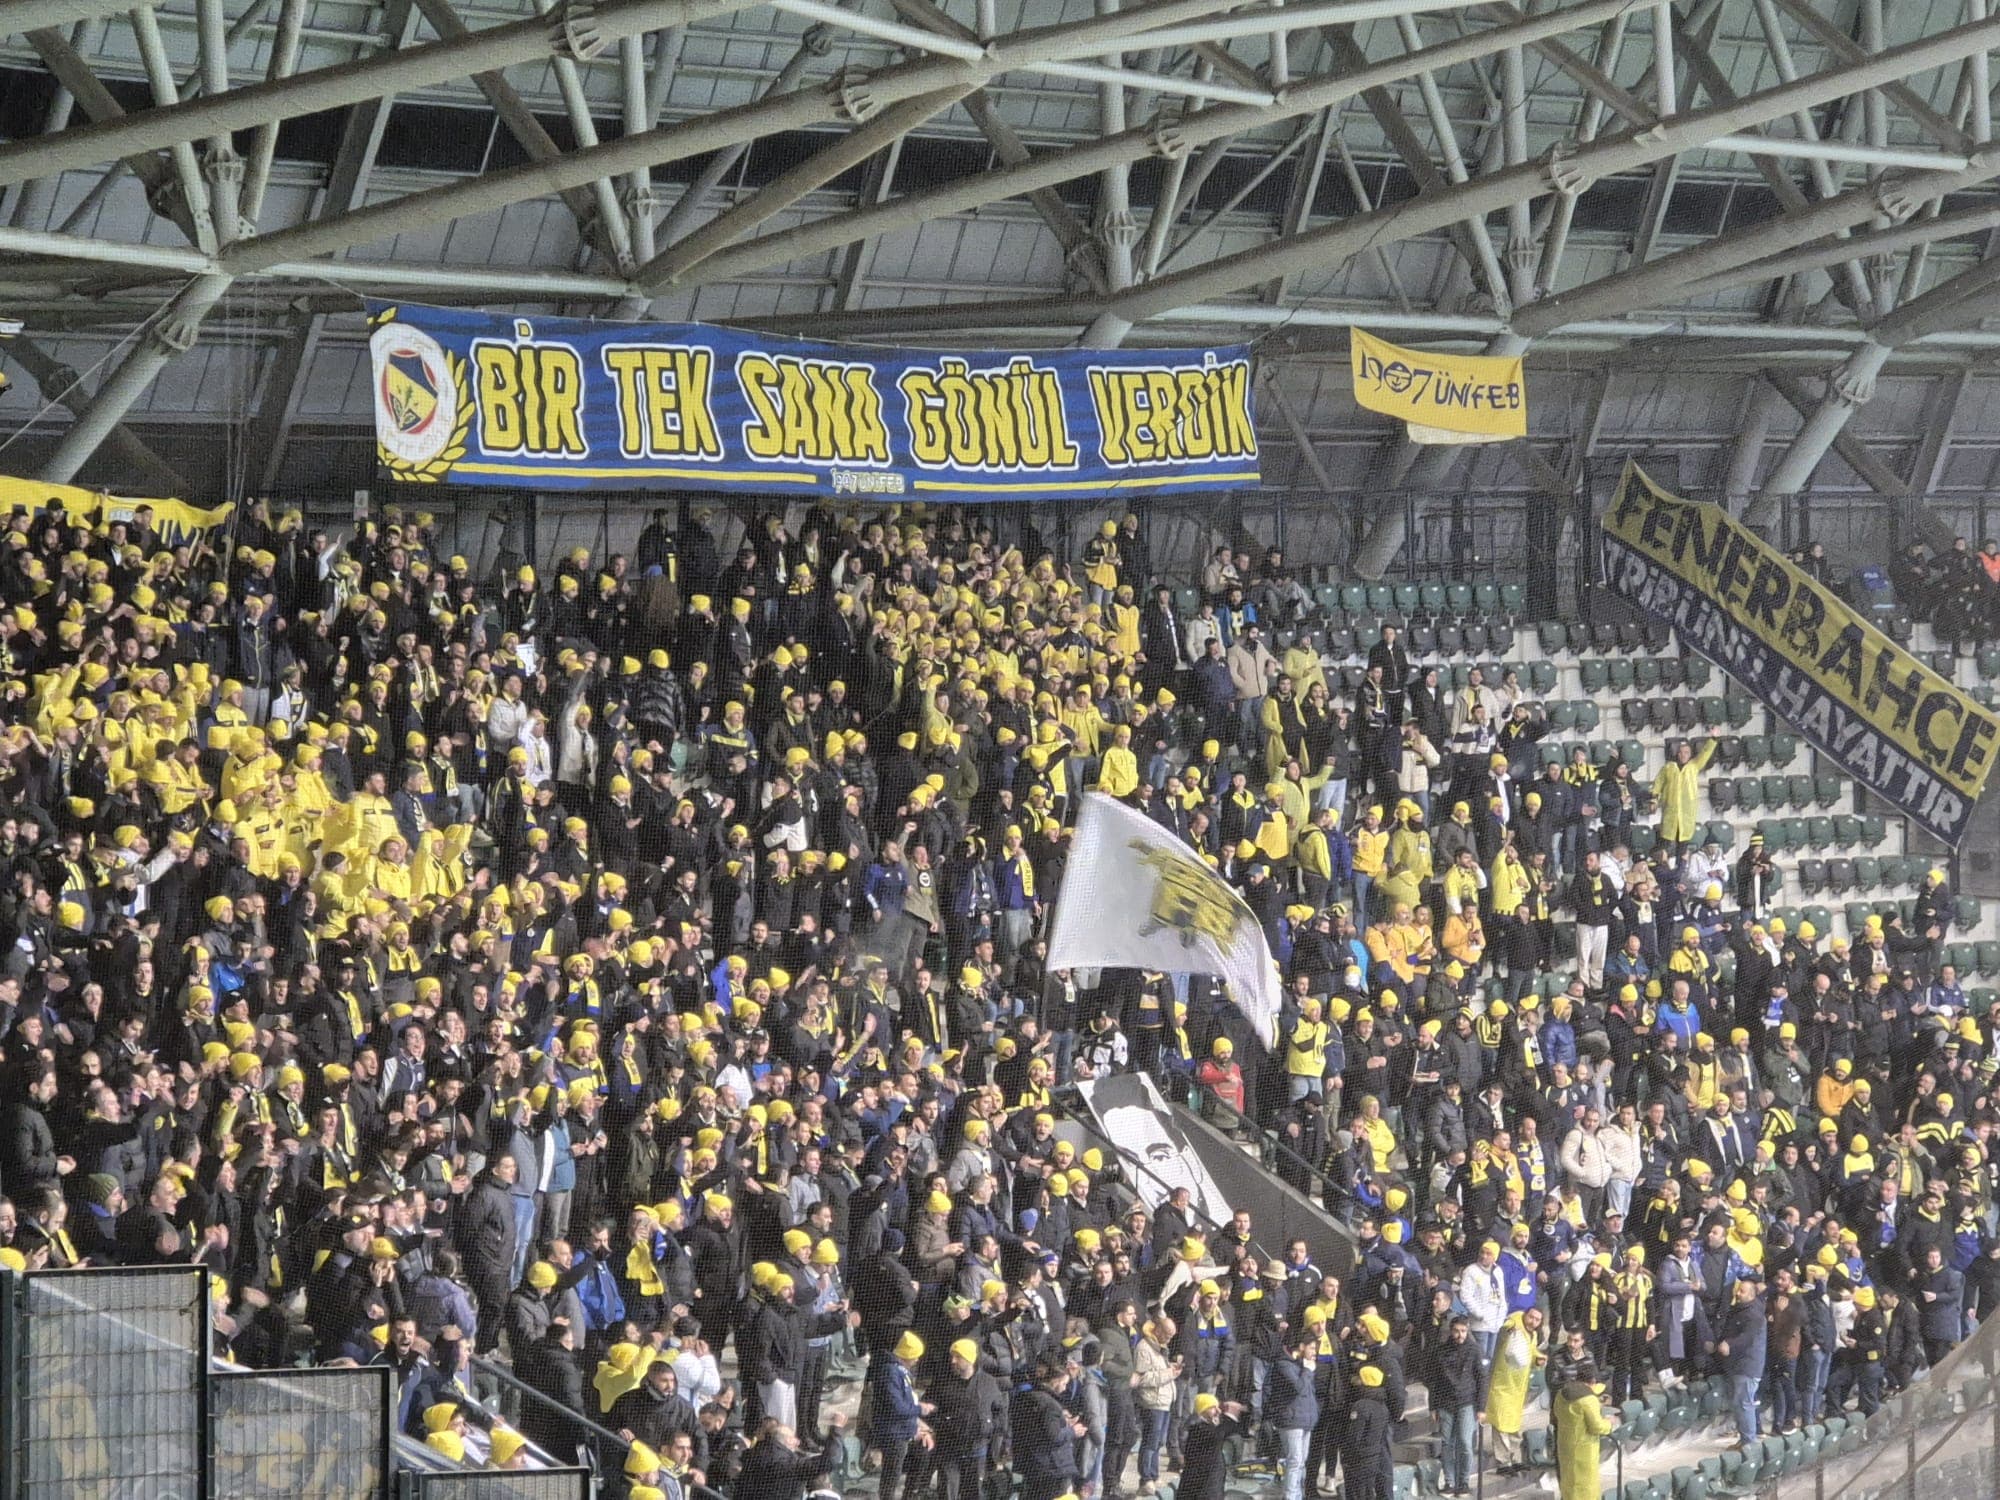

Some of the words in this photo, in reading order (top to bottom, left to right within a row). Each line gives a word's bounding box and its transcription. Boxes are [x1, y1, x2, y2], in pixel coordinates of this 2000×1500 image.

[472, 319, 588, 460] BİR
[602, 343, 726, 461] TEK
[735, 351, 893, 468] SANA
[897, 355, 1081, 471] GÖNÜL
[1087, 352, 1258, 469] VERDİK
[1769, 657, 1964, 835] HAYATTIR
